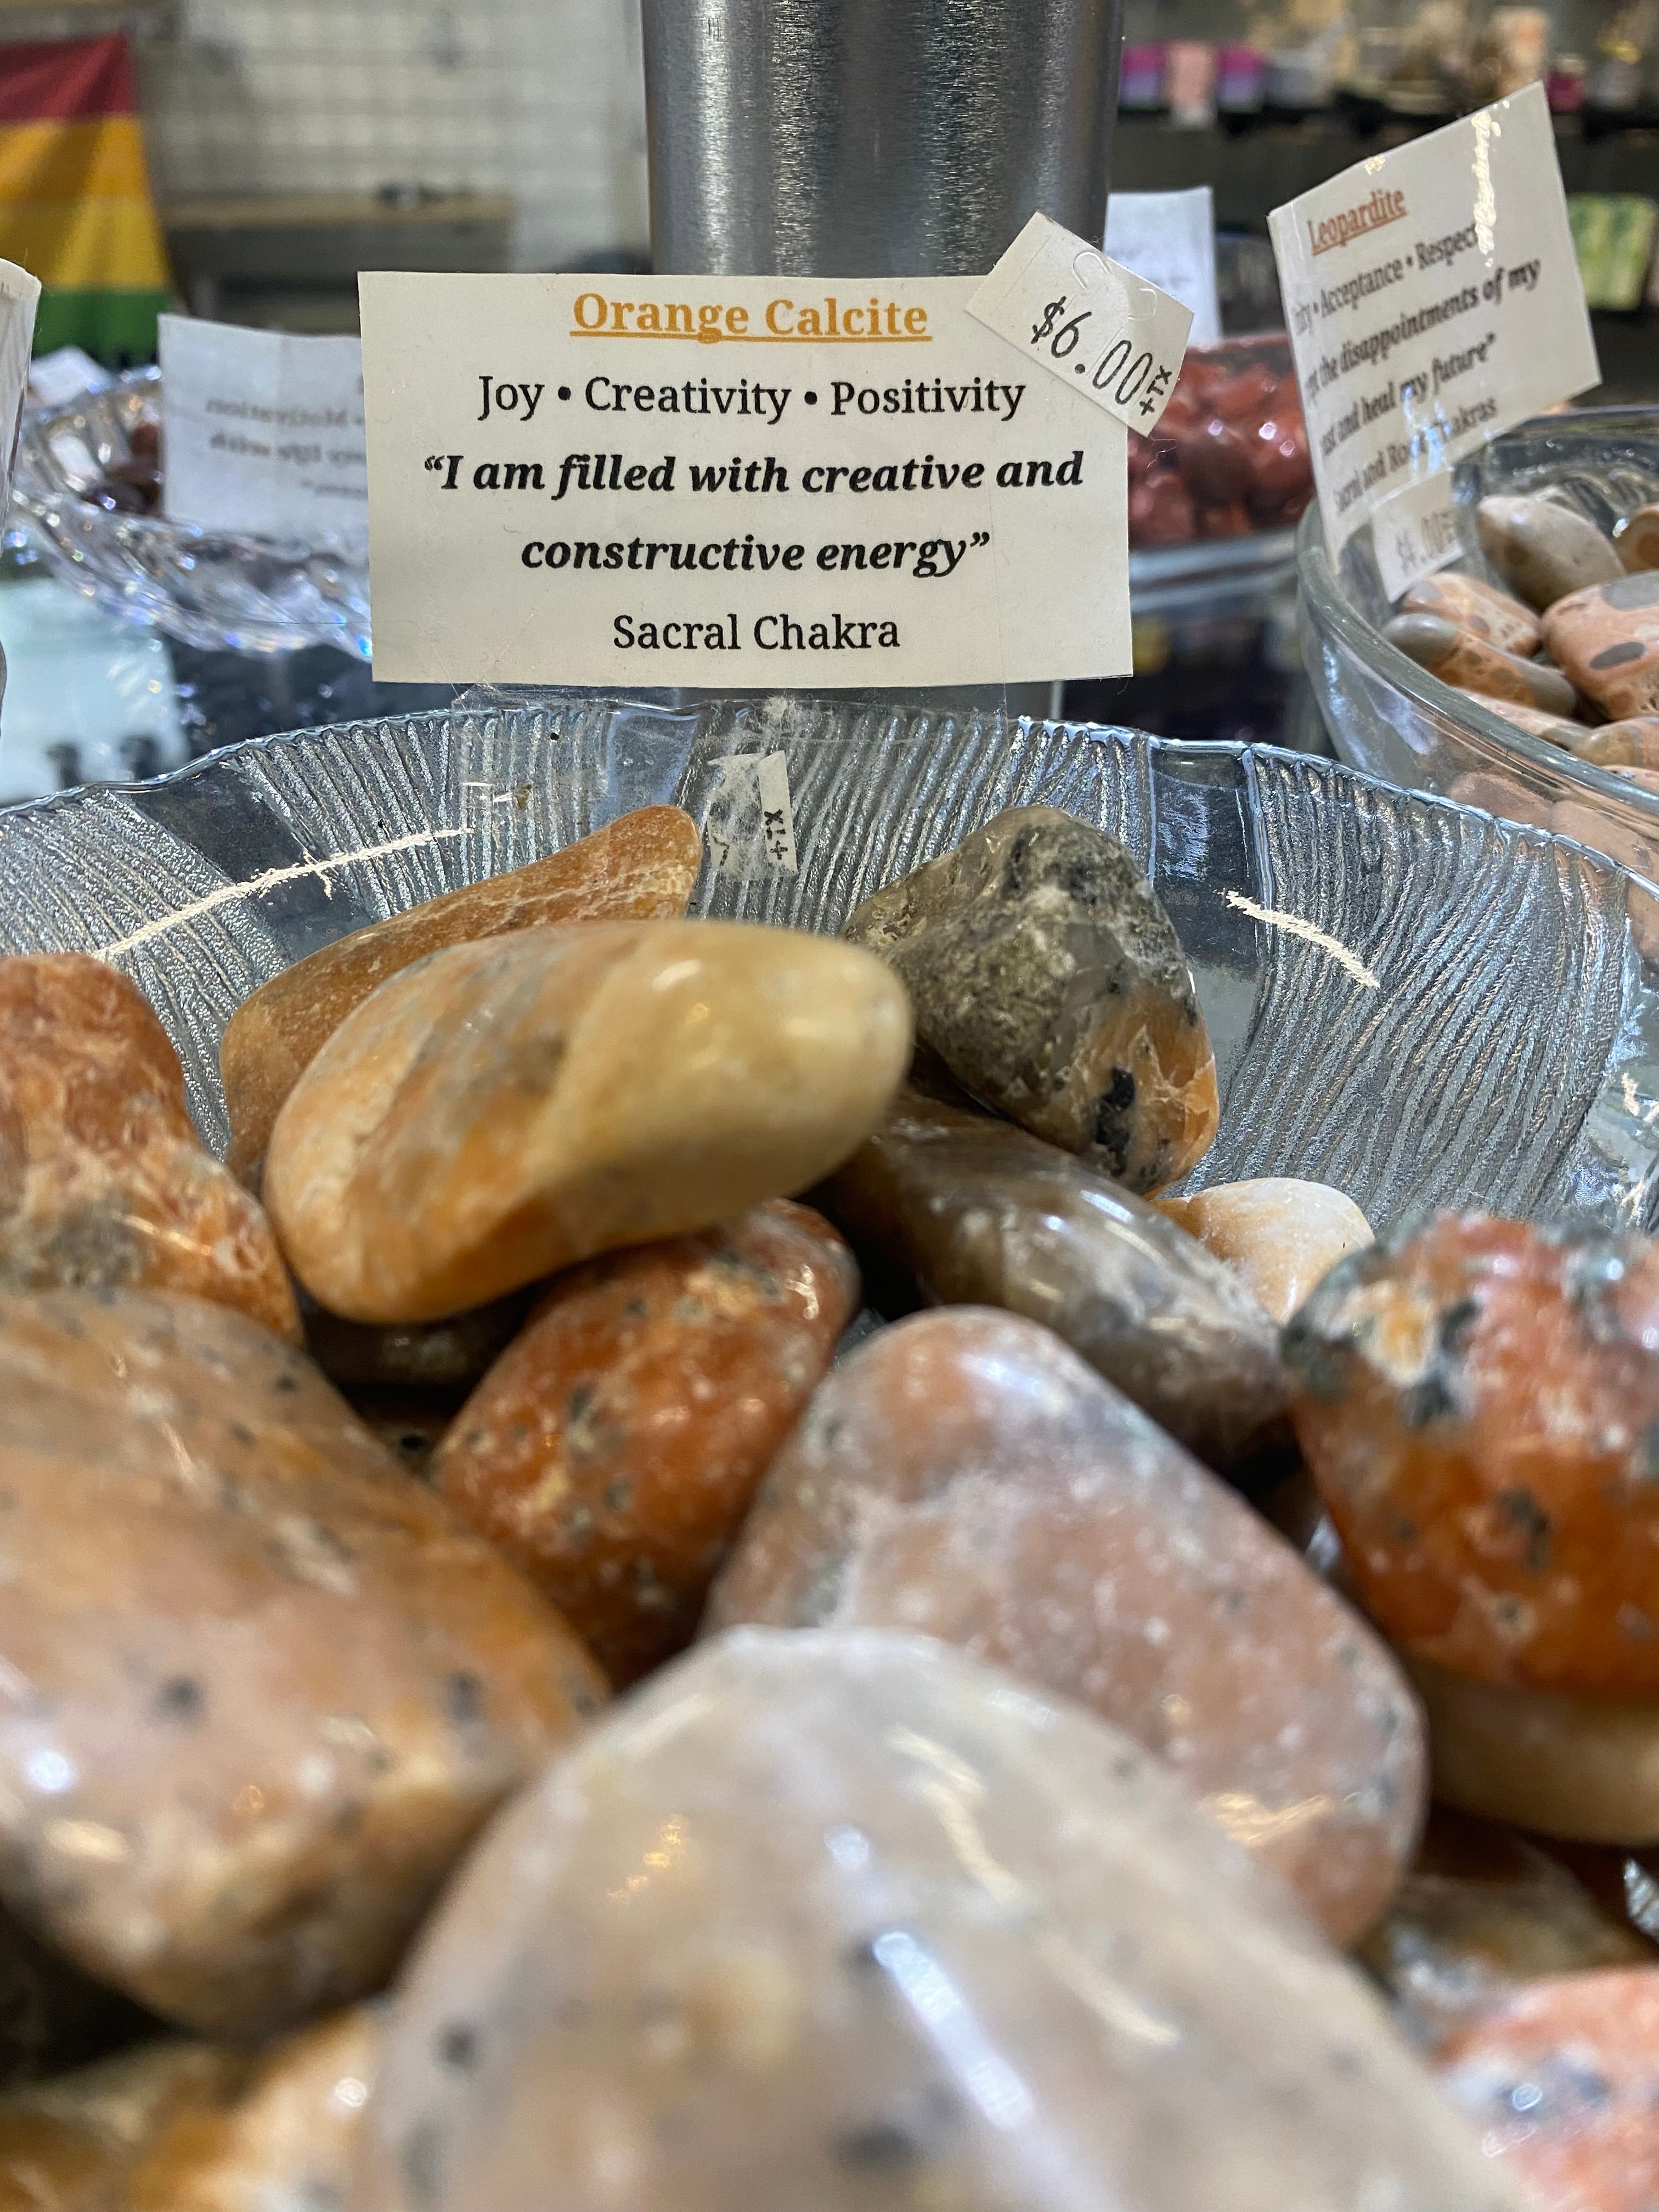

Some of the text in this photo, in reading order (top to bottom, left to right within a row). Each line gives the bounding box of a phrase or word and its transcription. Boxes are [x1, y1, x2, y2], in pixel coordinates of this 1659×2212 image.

[1307, 188, 1407, 250] Leopardite
[1321, 255, 1404, 318] Acceptance
[1341, 285, 1479, 365] disappointments
[1483, 267, 1504, 305] of
[1509, 257, 1542, 292] my
[573, 292, 928, 343] Orange Calcite
[1031, 296, 1153, 405] $6.00
[478, 376, 1025, 425] Joy Creativity Positivity
[473, 463, 545, 489] am
[551, 454, 675, 500] filled
[689, 456, 789, 492] with
[802, 455, 985, 493] creative
[996, 451, 1084, 488] and
[522, 534, 804, 571] constructive
[614, 613, 900, 650] Sacral Chakra
